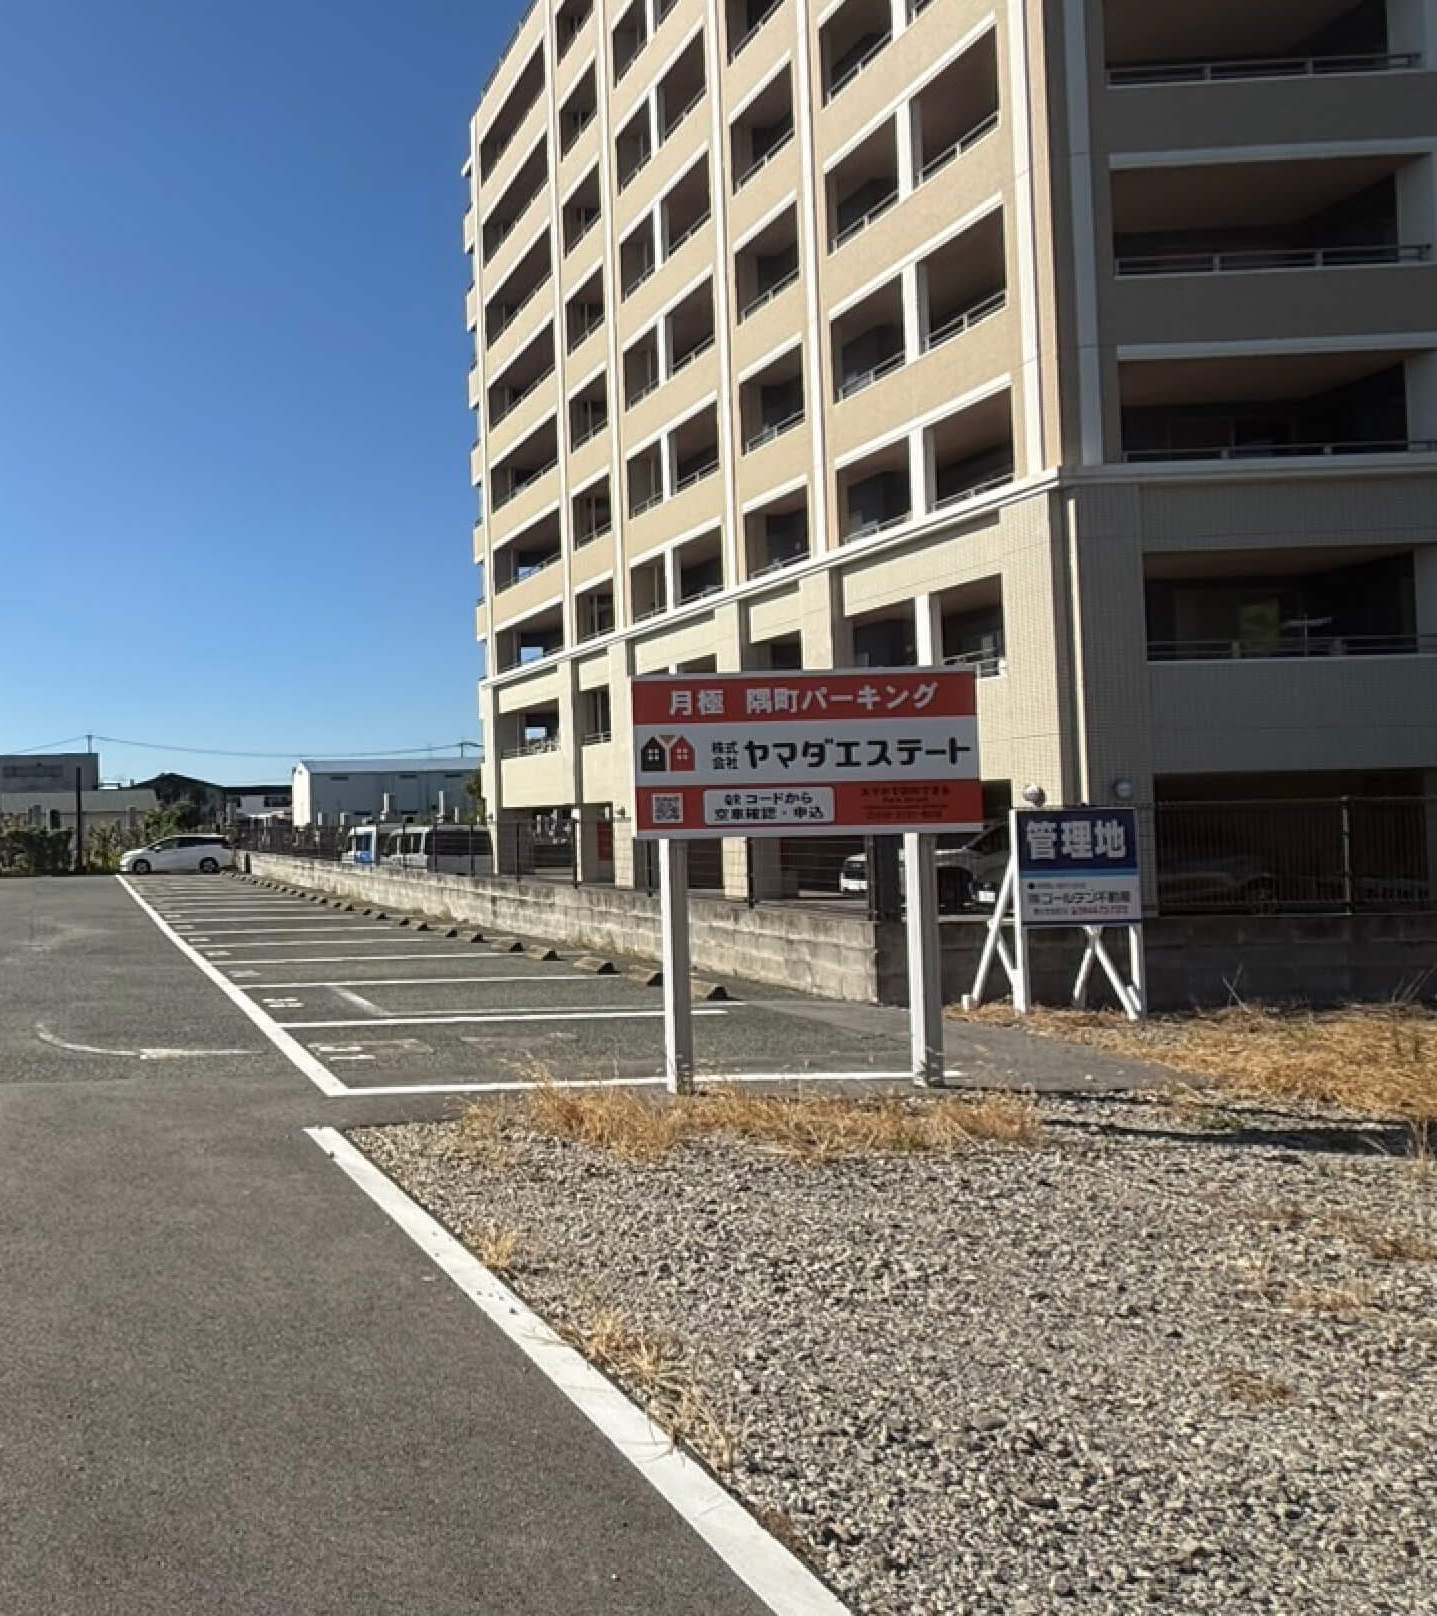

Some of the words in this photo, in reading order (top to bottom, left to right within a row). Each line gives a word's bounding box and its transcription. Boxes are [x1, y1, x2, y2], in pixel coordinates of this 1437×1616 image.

[669, 689, 725, 715] 月極
[745, 682, 939, 713] 隅町パーキング
[744, 736, 971, 769] ヤマダエステート
[1026, 819, 1126, 860] 管理地
